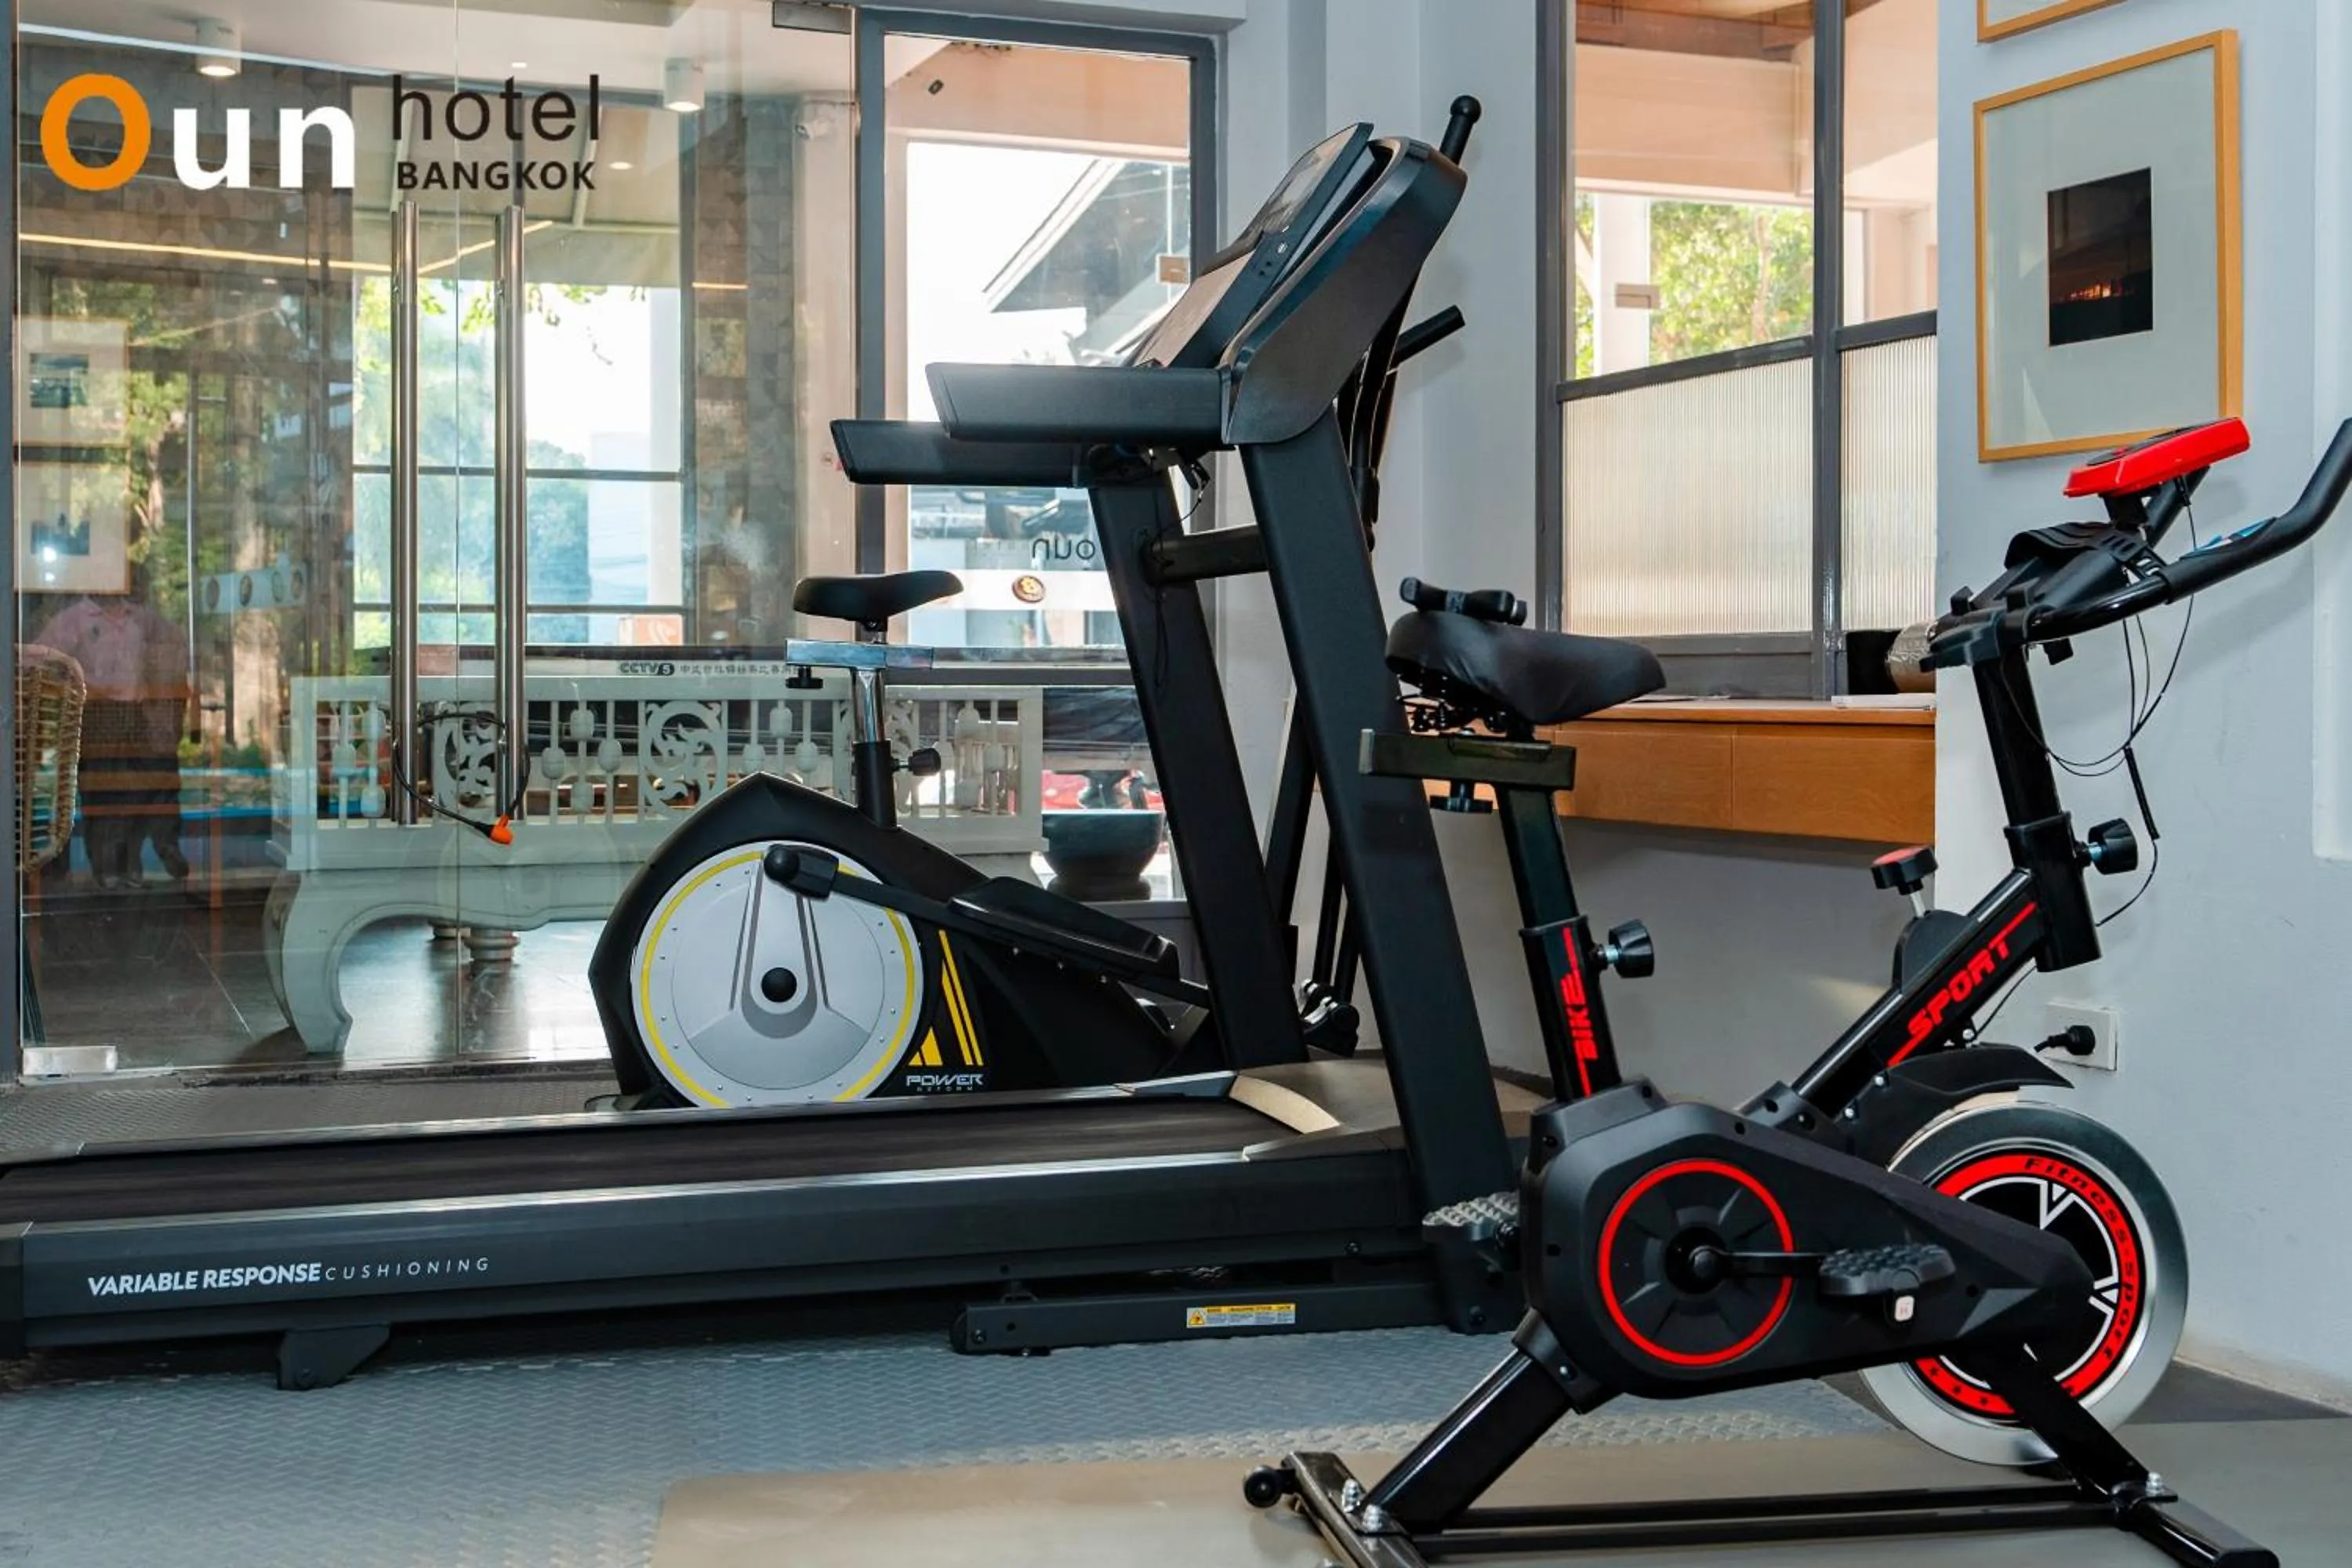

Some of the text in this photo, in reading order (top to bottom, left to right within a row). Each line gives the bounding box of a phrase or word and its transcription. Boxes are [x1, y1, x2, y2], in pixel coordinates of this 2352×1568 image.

[1886, 902, 2037, 1068] SPORT
[906, 1073, 984, 1087] POWER
[87, 1257, 489, 1296] VARIABLE RESPONSE CUSHIONING
